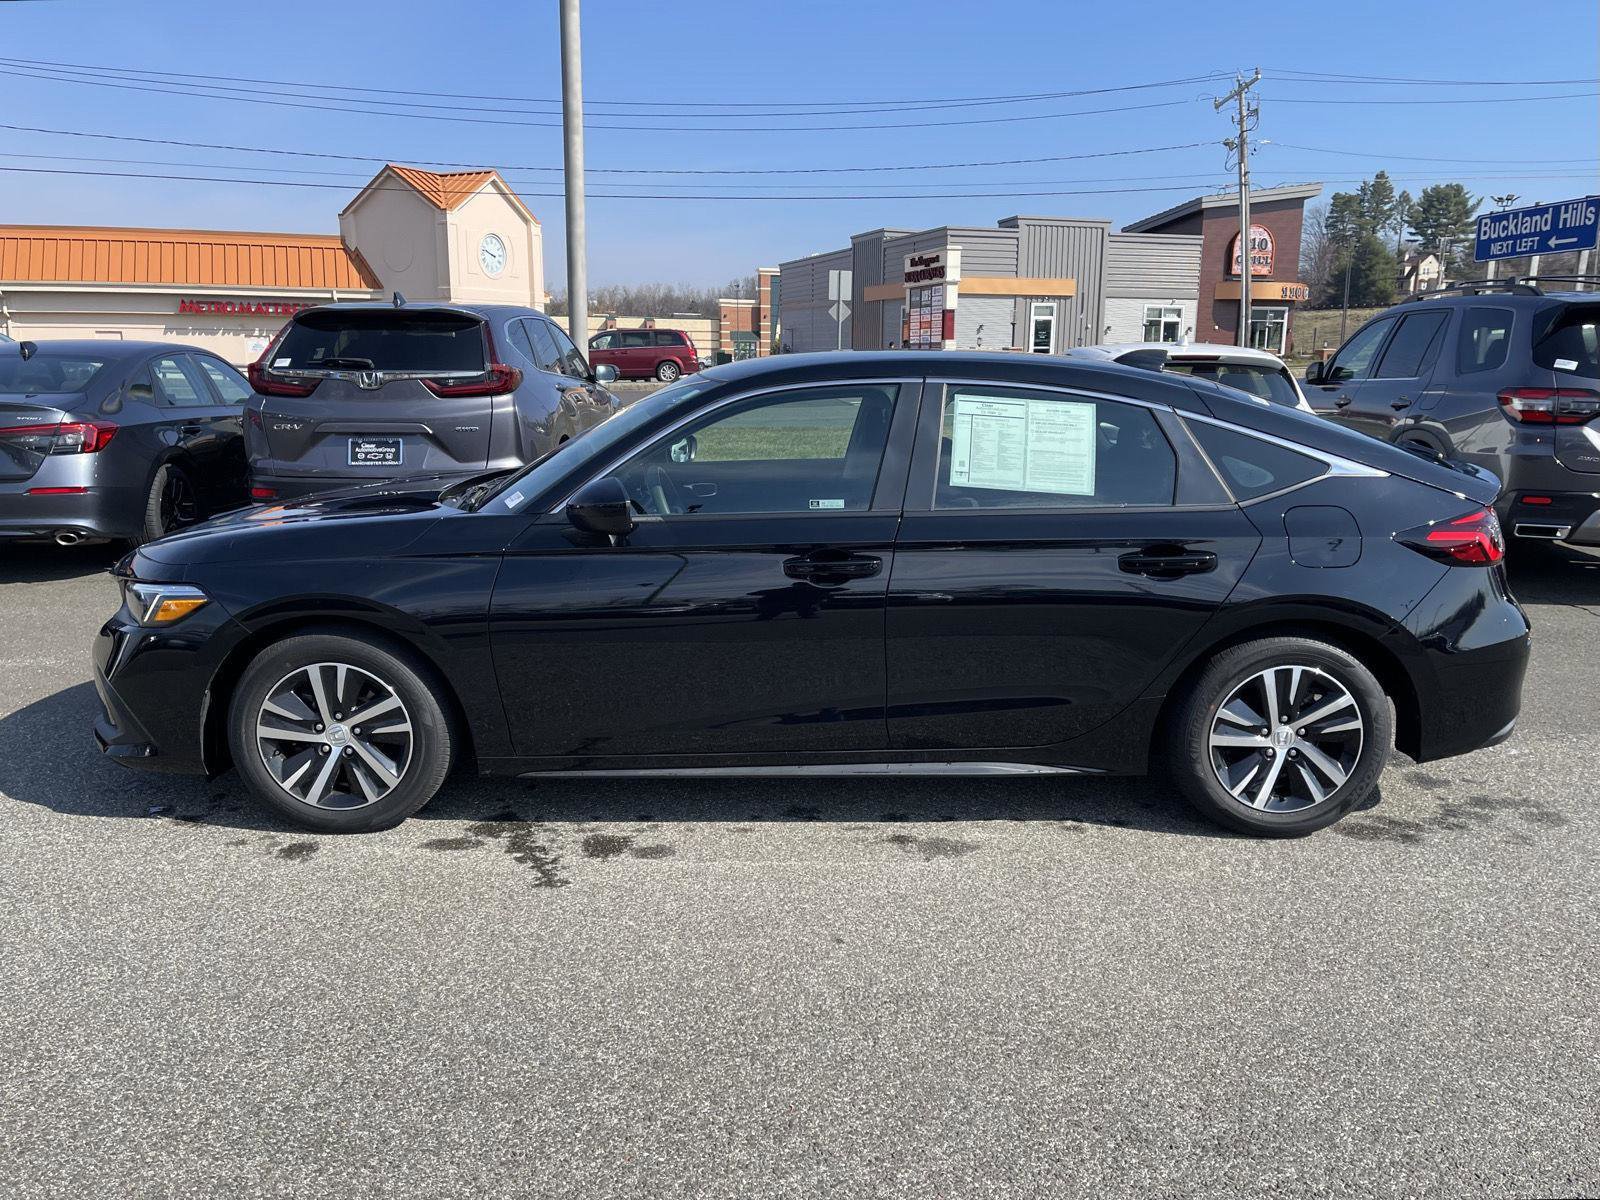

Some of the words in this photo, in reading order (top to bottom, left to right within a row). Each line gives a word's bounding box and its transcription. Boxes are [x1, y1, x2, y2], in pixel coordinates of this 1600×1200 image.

[1480, 208, 1553, 240] Buckland
[1558, 201, 1596, 229] Hills
[1243, 237, 1269, 250] 10
[1490, 240, 1514, 255] NEXT
[1516, 237, 1540, 252] LEFT
[1236, 254, 1271, 265] GILL
